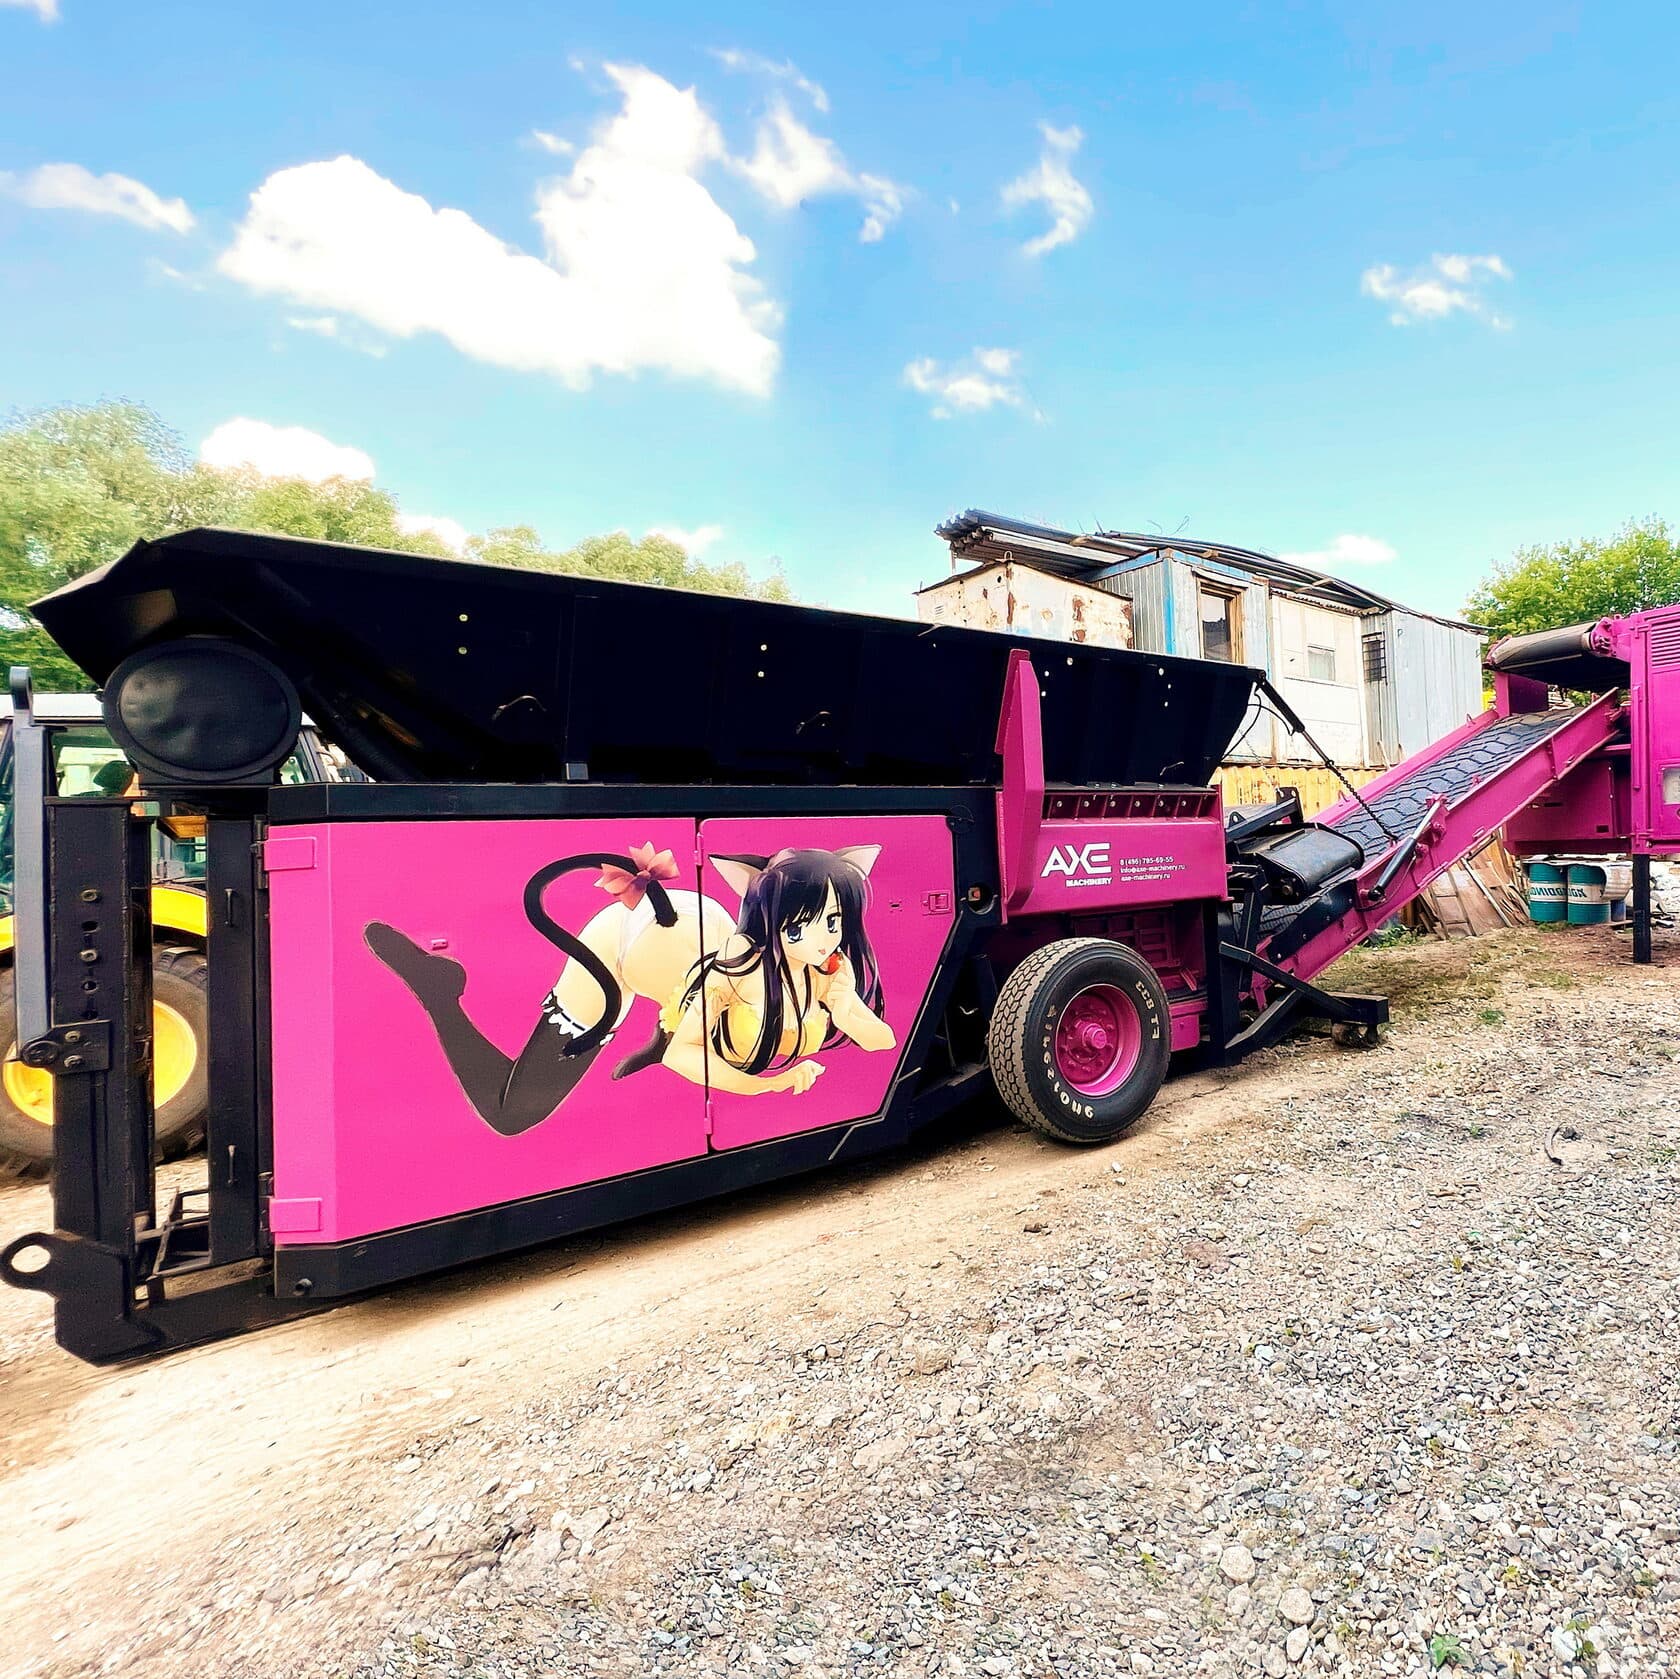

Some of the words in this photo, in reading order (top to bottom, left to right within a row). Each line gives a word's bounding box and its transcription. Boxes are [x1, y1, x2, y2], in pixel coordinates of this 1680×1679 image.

[1040, 843, 1112, 877] AXE
[1120, 864, 1186, 874] info@axe-machinery.ru
[1066, 877, 1112, 887] MACHINERY
[1121, 873, 1171, 882] axe-machinery.ru
